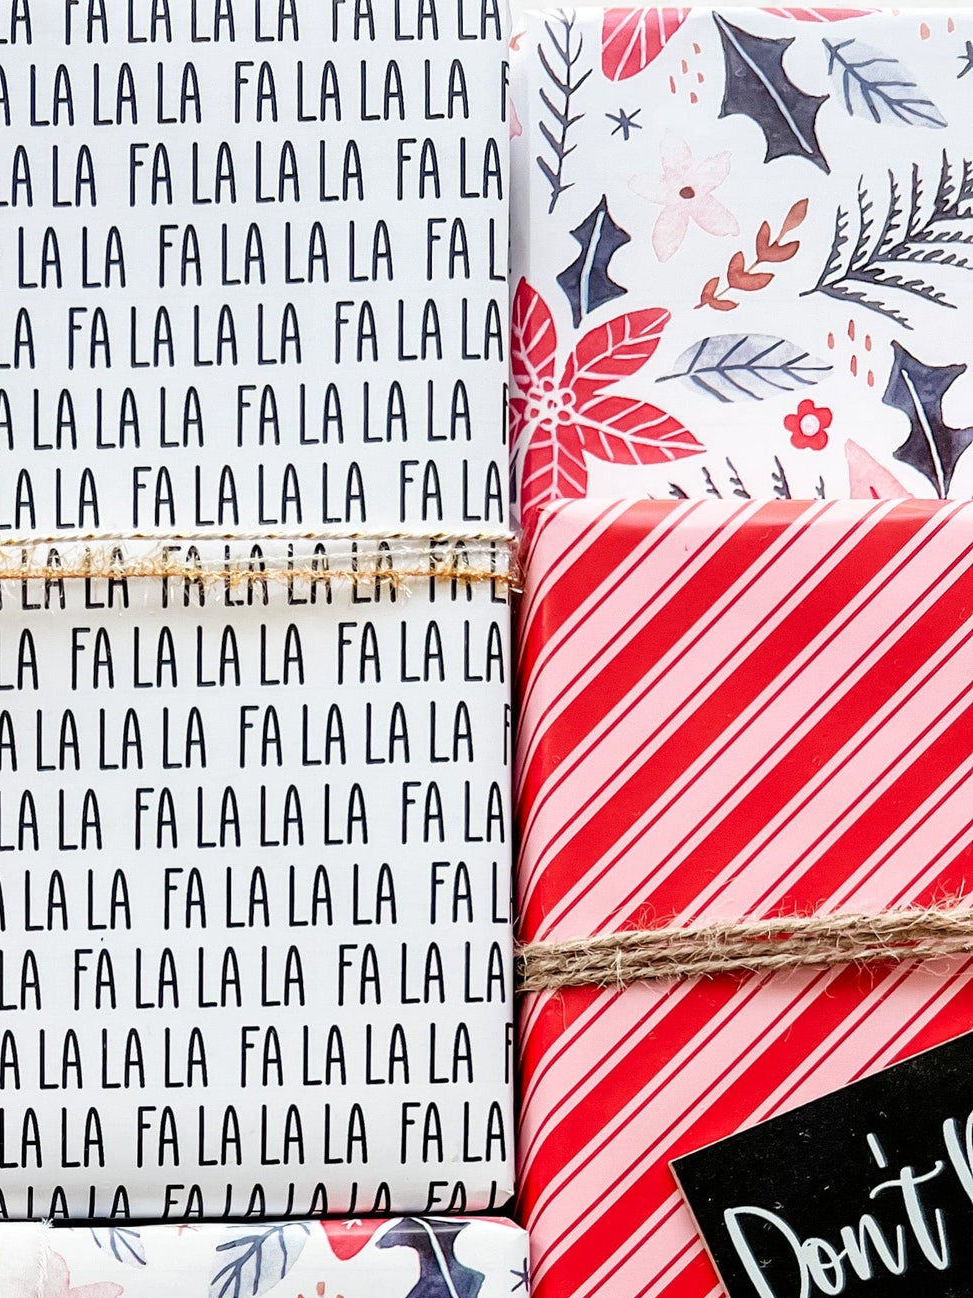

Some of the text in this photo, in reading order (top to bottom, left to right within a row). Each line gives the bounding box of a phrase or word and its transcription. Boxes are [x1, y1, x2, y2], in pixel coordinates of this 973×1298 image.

[31, 64, 74, 126] LA
[94, 63, 137, 125] LA
[158, 62, 201, 124] LA
[235, 61, 277, 123] FA
[298, 61, 341, 122] LA
[361, 60, 404, 121] LA
[425, 59, 469, 119] LA
[69, 307, 111, 370] FA
[131, 306, 174, 368] LA
[194, 304, 237, 366] LA
[258, 303, 301, 365] LA
[335, 301, 378, 364] FA
[398, 299, 442, 361] LA
[462, 299, 504, 362] LA
[37, 709, 80, 771] LA
[100, 708, 143, 770] LA
[163, 707, 206, 769] LA
[240, 705, 282, 768] FA
[303, 704, 346, 766] LA
[366, 702, 409, 764] LA
[430, 701, 473, 762] LA
[75, 949, 116, 1010] FA
[136, 948, 179, 1008] LA
[0, 1108, 42, 1168] LA
[62, 1107, 104, 1168] LA
[137, 1106, 179, 1168] FA
[199, 1105, 242, 1166] LA
[261, 1104, 304, 1165] LA
[324, 1103, 367, 1164] LA
[401, 1102, 443, 1164] FA
[463, 1101, 506, 1162] LA
